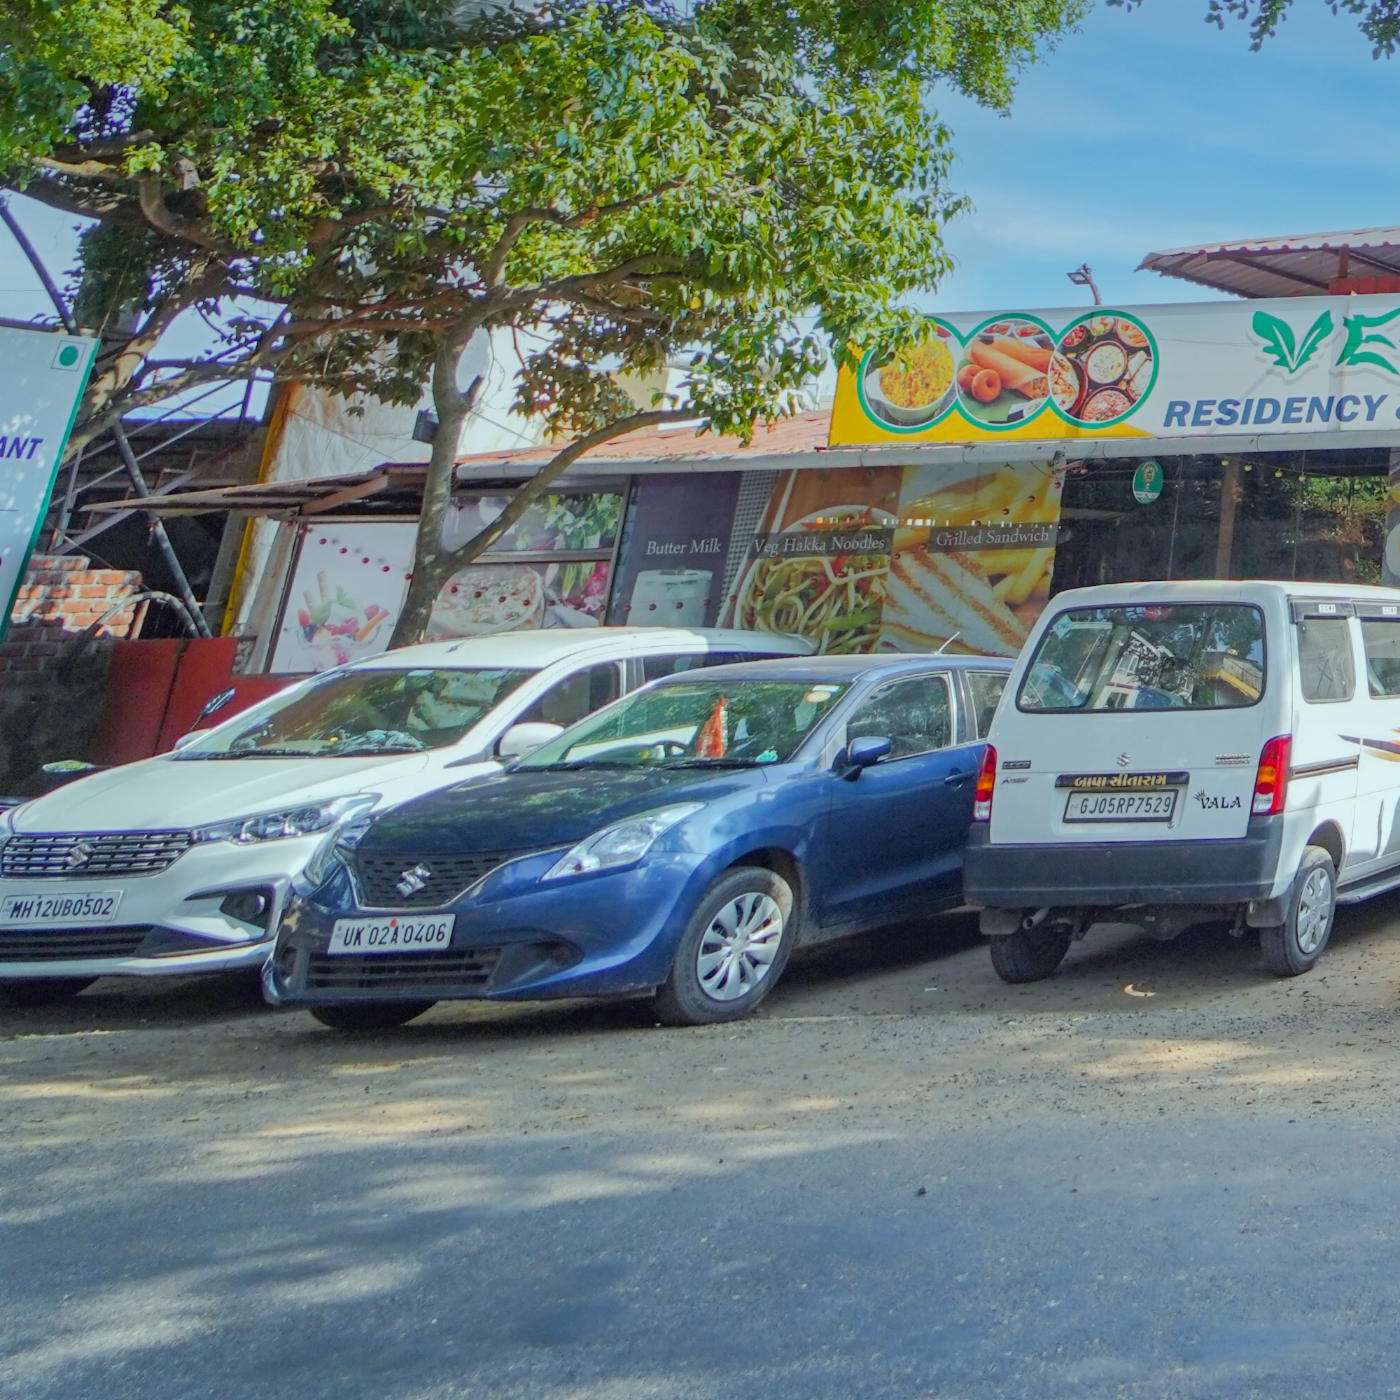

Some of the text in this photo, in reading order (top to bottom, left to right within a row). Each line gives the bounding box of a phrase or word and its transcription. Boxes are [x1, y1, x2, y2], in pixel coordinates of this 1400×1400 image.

[1163, 393, 1389, 427] RESIDENCY
[647, 537, 721, 556] Butter Milk
[754, 534, 885, 558] Veg Hakka Noodles
[936, 528, 1049, 548] Grilled Sandwich
[1080, 795, 1171, 815] GJ05RP7529
[1201, 795, 1242, 809] VALA
[10, 898, 114, 919] MH12UB0502
